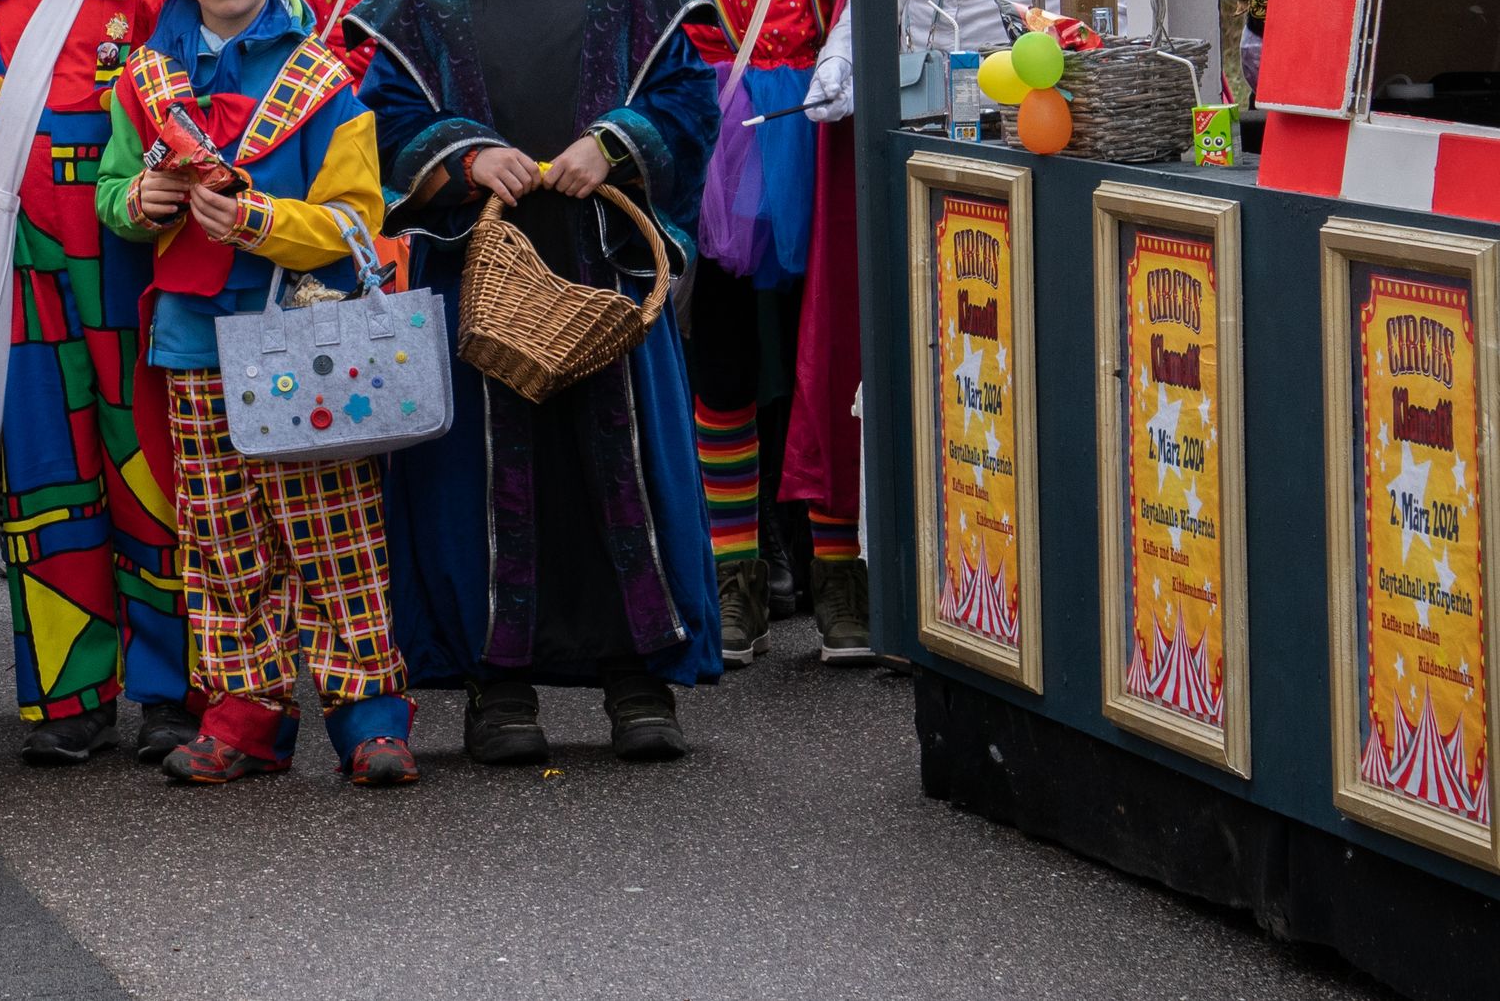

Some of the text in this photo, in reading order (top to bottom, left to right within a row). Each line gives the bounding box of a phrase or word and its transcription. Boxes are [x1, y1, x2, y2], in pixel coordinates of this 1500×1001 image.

[954, 229, 1000, 289] CIRCUS
[1147, 268, 1202, 334] CIRCUS
[1386, 315, 1454, 389] CIRCUS
[956, 374, 1003, 416] 2. März 2024
[1148, 426, 1205, 473] 2. März 2024
[1141, 498, 1215, 540] Gaytalhalle Körperich
[1390, 489, 1459, 543] 2. März 2024
[1142, 538, 1189, 567] Kaffee und Kuchen
[1379, 567, 1472, 617] Gaytalhalle Körperich
[1381, 612, 1440, 646] Kaffee und Kuchen
[1418, 655, 1475, 688] Kinderschminken
